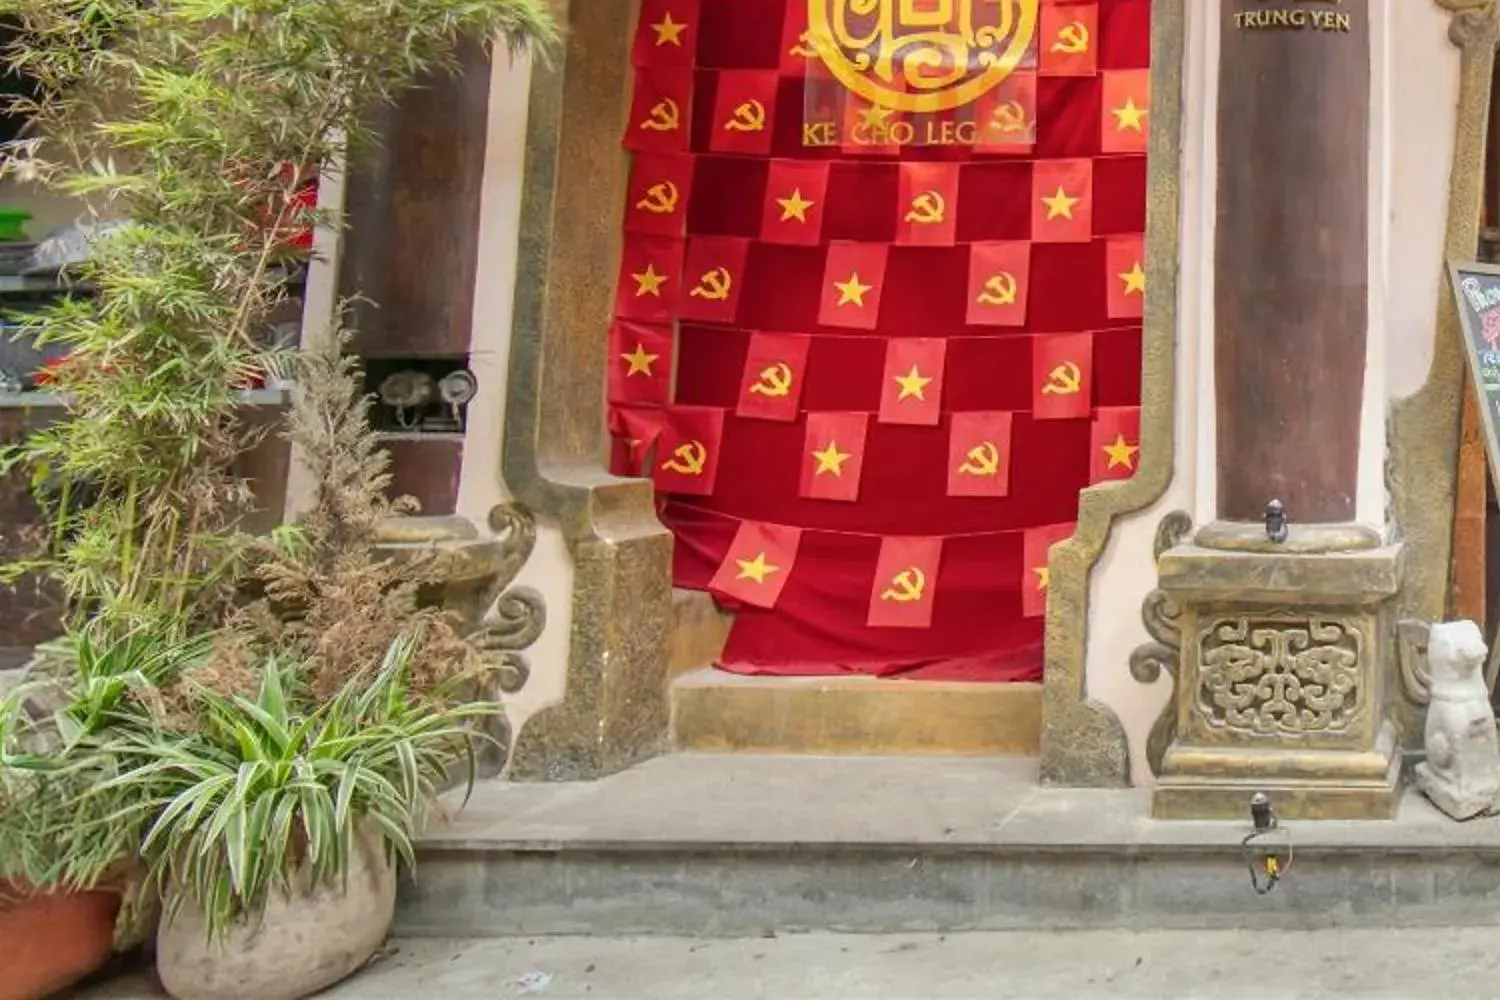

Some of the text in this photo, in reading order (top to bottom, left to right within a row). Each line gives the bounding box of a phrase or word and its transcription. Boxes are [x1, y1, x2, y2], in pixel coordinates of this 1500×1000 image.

[1233, 7, 1351, 32] TRUNG YEN
[802, 122, 836, 145] KE
[851, 121, 914, 145] CHO
